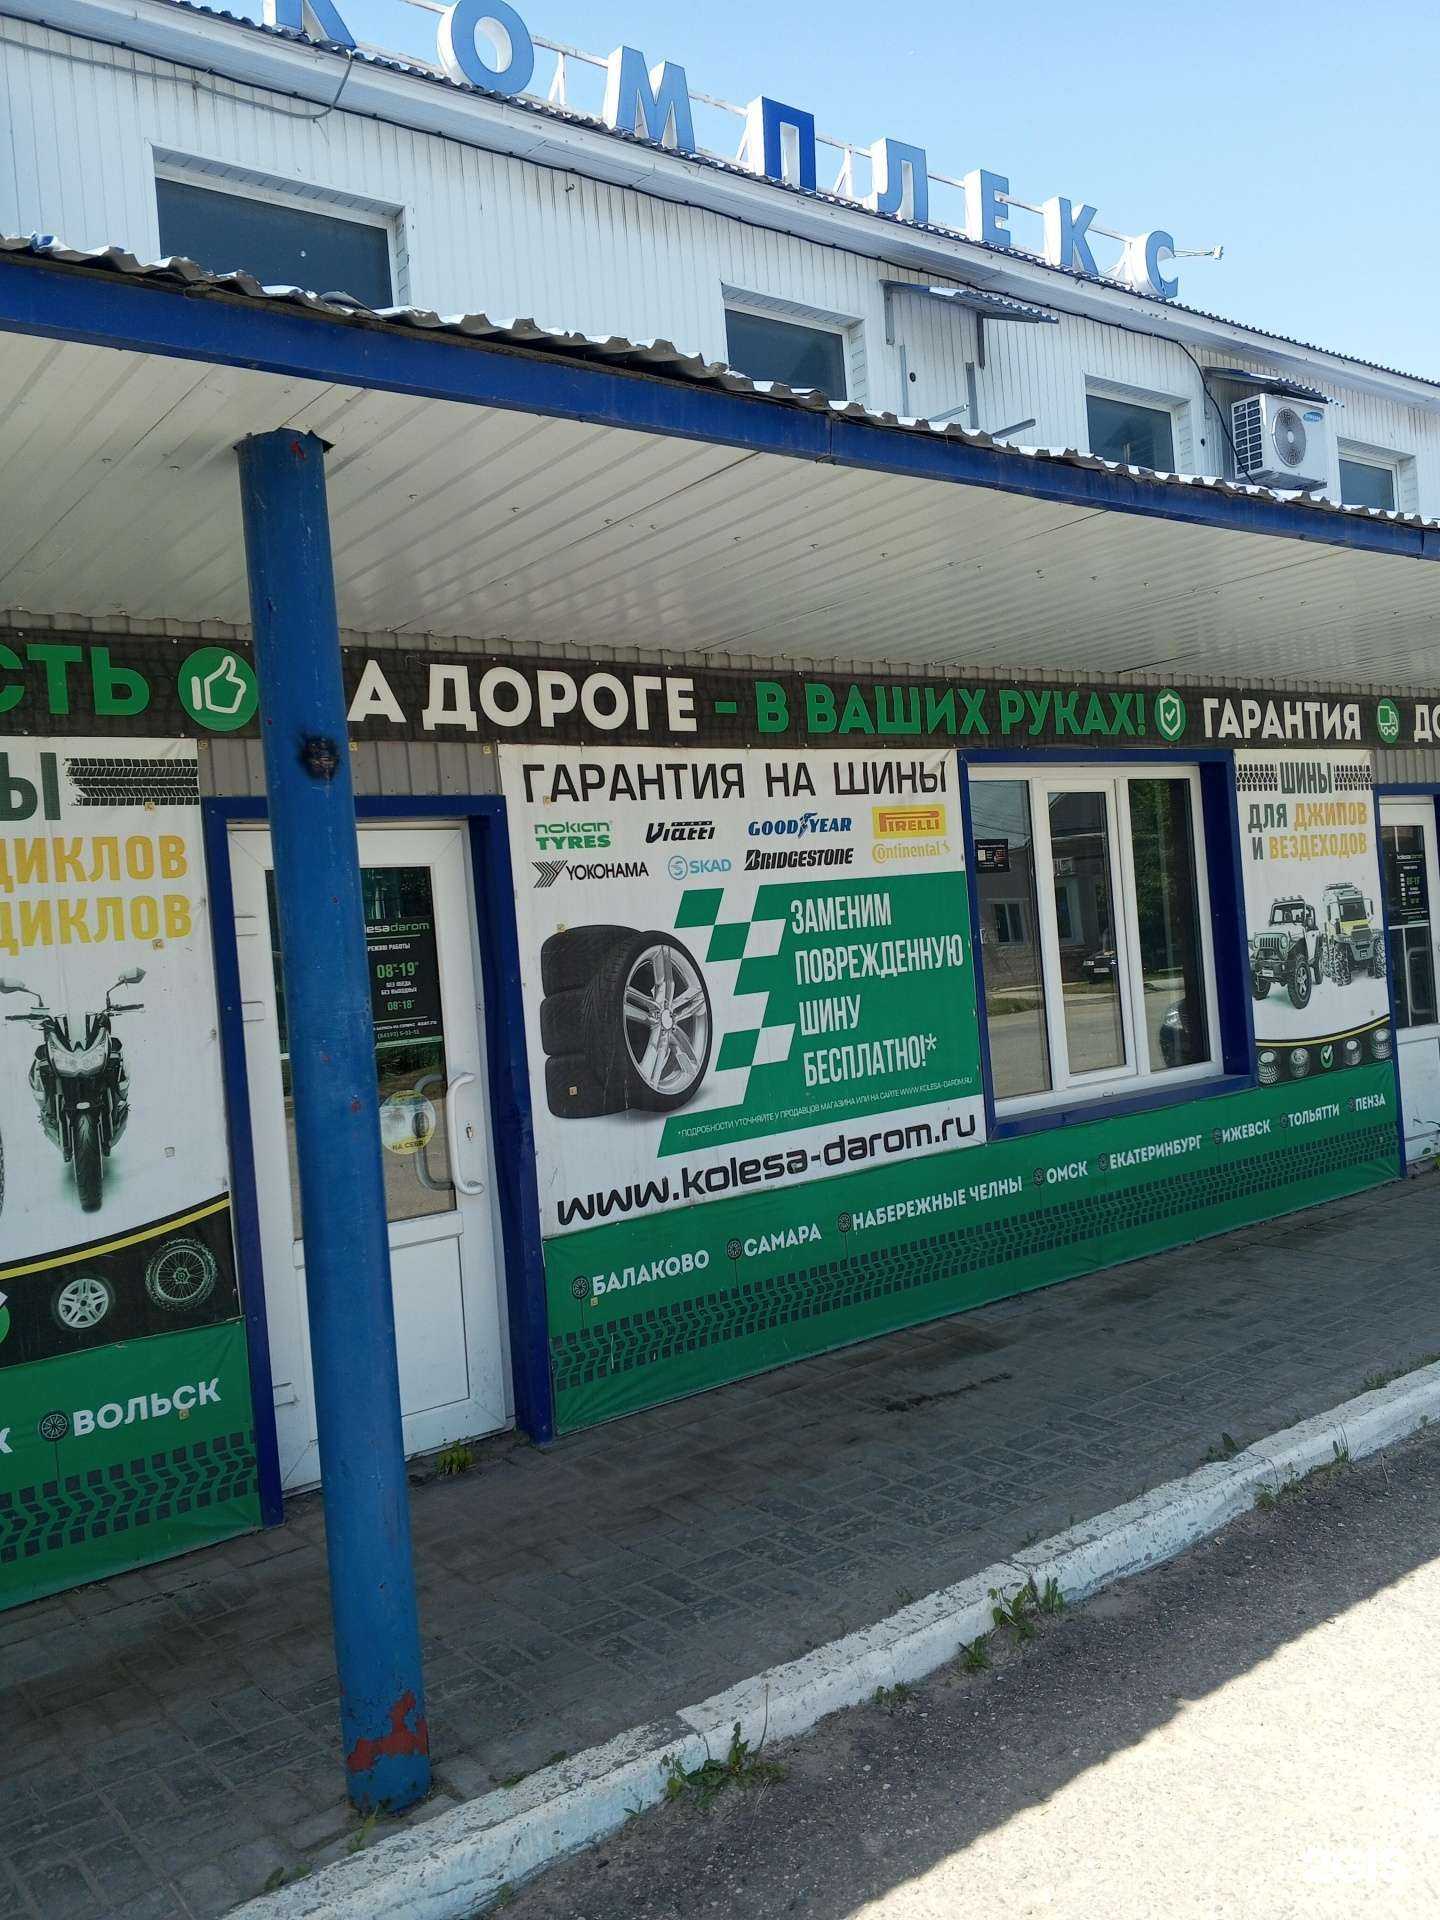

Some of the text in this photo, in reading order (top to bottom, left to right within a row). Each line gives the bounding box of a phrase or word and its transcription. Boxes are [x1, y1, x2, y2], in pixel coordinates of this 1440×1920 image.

[422, 663, 698, 732] ДОРОГЕ
[755, 681, 790, 734] В
[805, 684, 990, 736] ВАШИХ
[1000, 688, 1146, 736] РУКАХ!
[1202, 698, 1362, 740] ГАРАНТИЯ
[522, 760, 947, 803] ГАРАНТИЯ НА ШИНЫ
[1279, 762, 1333, 794] ШИНЫ
[879, 810, 940, 833] PIRELLI
[1248, 801, 1368, 833] ДЛЯ ДЖИПОВ
[536, 834, 612, 850] TYRES
[872, 840, 941, 864] Continental
[1252, 833, 1367, 861] И ВЕЗДЕХОДОВ
[566, 861, 650, 881] YOKOHAMA
[689, 858, 732, 874] SKAD
[744, 847, 854, 871] BRIDGESTONE
[790, 892, 892, 935] ЗАМЕНИМ
[794, 933, 964, 986] ПОВРЕЖДЕННУЮ
[798, 995, 862, 1036] ШИНУ
[820, 1099, 856, 1111] МАГАЗИНА
[1287, 1103, 1341, 1128] ТОЛЬЯТТИ
[1355, 1092, 1386, 1113] ПЕНЗА
[1221, 1118, 1272, 1144] ИЖЕВСК
[1110, 1134, 1203, 1170] ЕКАТЕРИНБУРГ
[557, 1111, 976, 1226] www.kolesa-darom.ru
[1046, 1160, 1088, 1185] ОМСК
[852, 1176, 1022, 1232] НАБЕРЕЖНЫЕ ЧЕЛНЫ
[744, 1223, 823, 1258] САМАРА
[592, 1249, 710, 1296] БАЛАКОВО
[72, 1377, 222, 1437] ВОЛЬСК
